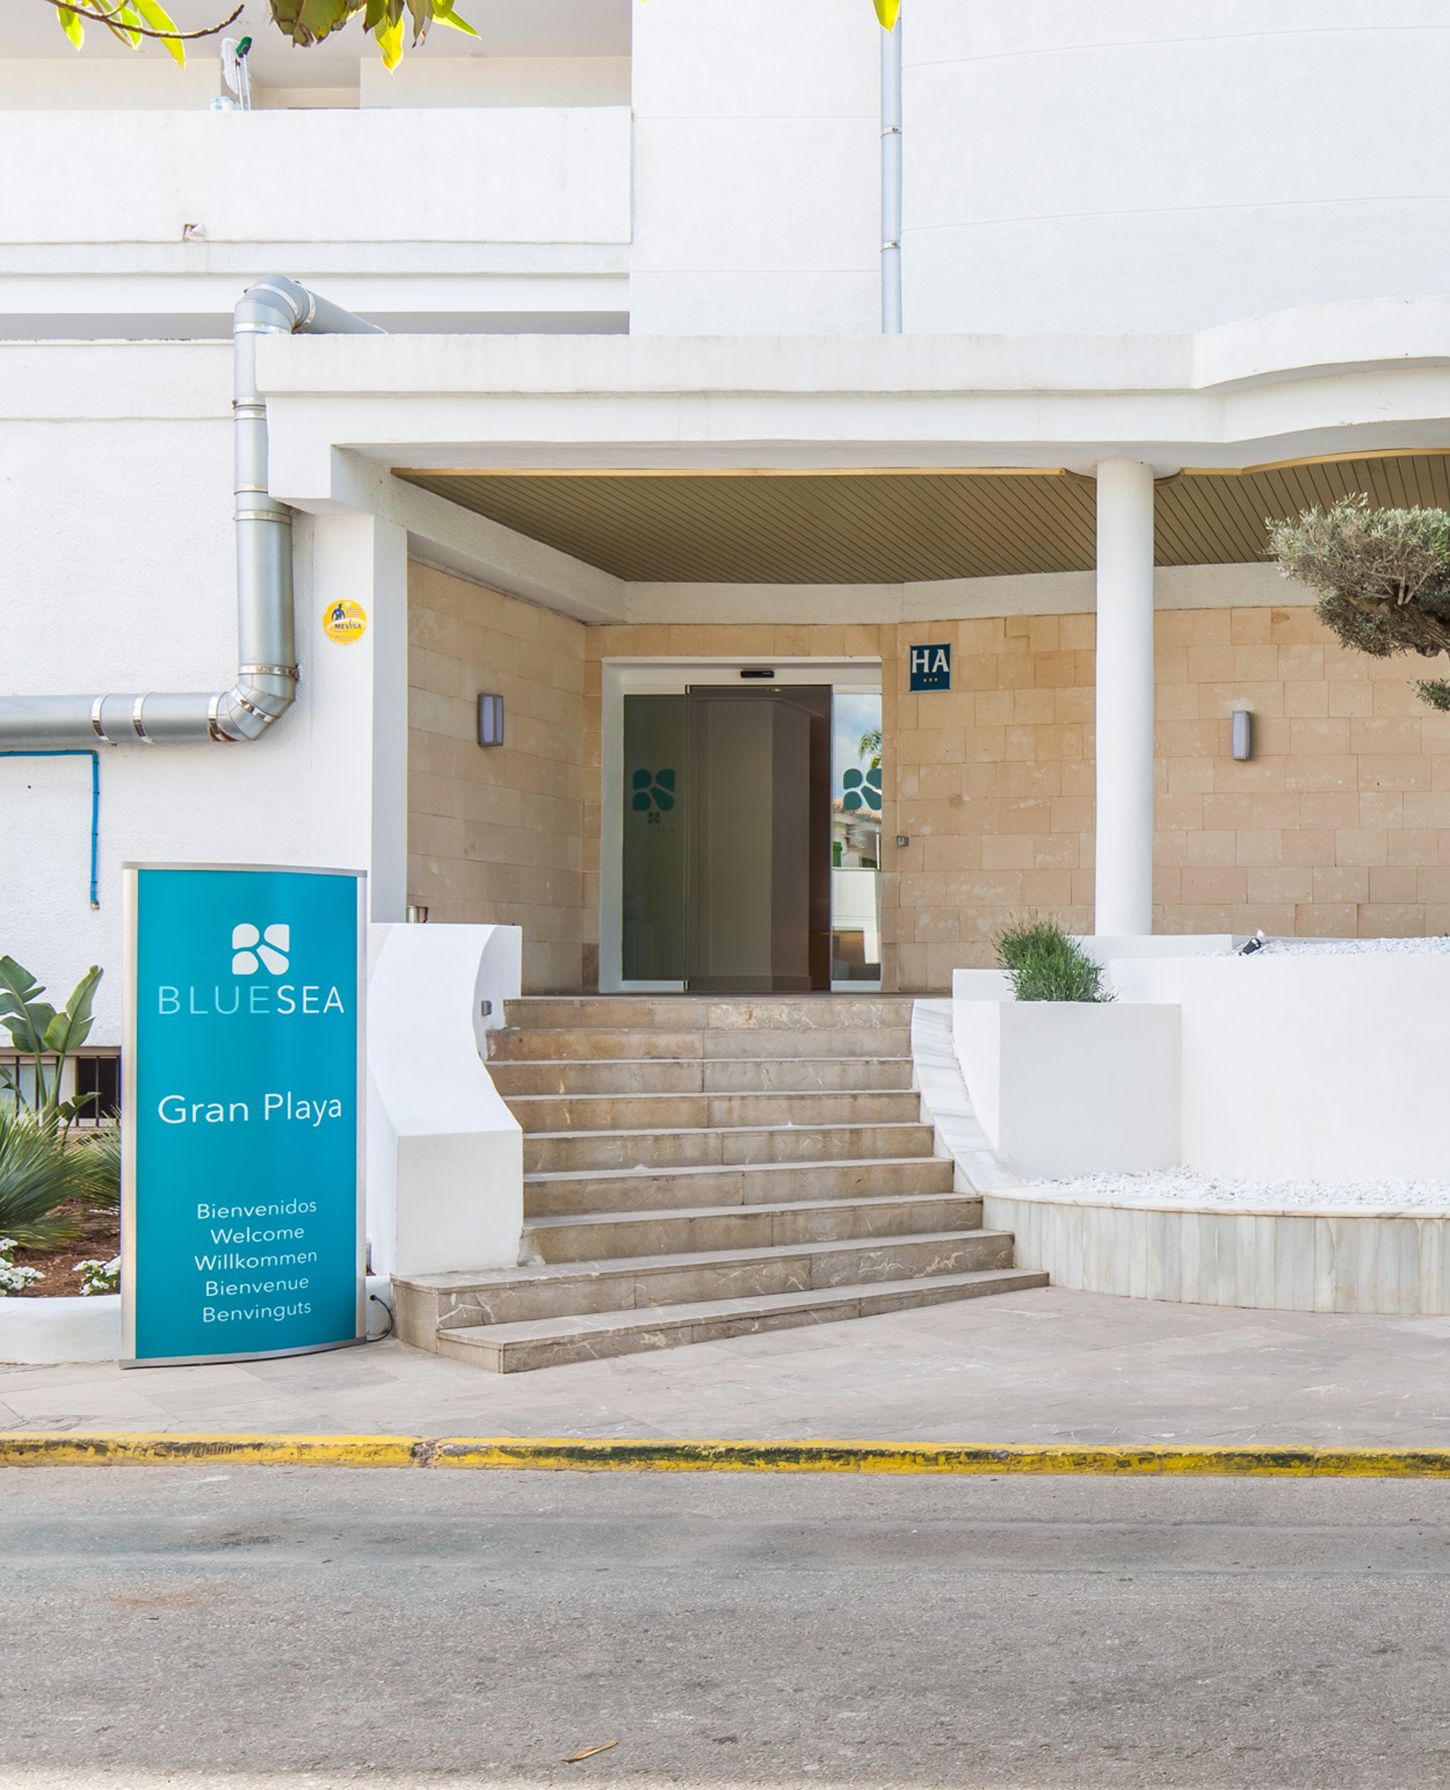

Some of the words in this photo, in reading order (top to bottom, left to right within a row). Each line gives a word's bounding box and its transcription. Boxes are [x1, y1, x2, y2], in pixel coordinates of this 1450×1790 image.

[911, 648, 950, 673] HA
[158, 984, 345, 1015] BLUESEA
[158, 1094, 249, 1125] Gran
[264, 1091, 342, 1127] Playa
[197, 1198, 317, 1219] Bienvenidos
[210, 1226, 304, 1244] Welcome
[194, 1251, 317, 1271] Willkommen
[205, 1277, 309, 1297] Bienvenue
[202, 1302, 312, 1323] Benvinguts
